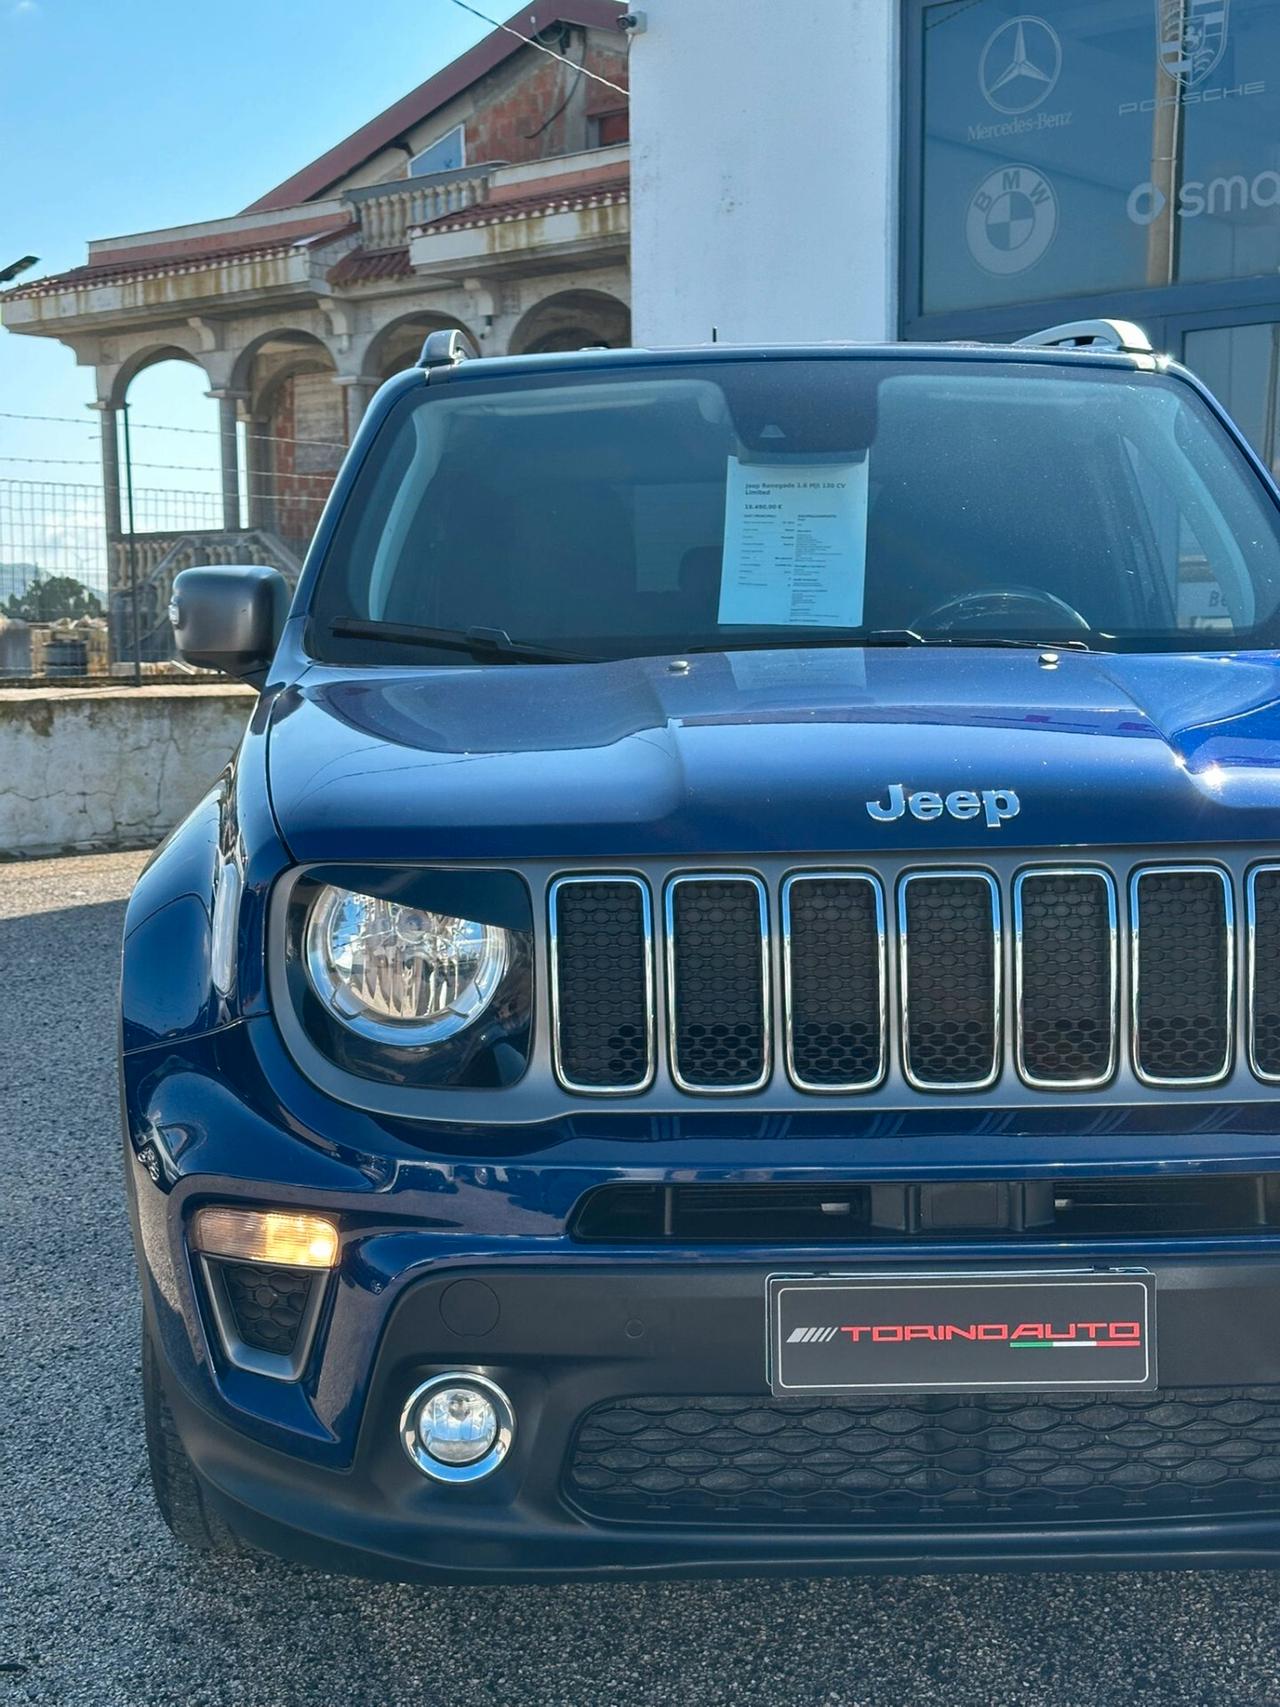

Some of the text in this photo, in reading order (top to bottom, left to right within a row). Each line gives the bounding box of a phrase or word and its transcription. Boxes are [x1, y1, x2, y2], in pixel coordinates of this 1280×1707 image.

[1118, 81, 1265, 117] PORSCHE
[967, 111, 1073, 142] Mercedes-Benz
[973, 169, 1052, 214] BMW
[762, 482, 795, 490] Renegade
[866, 784, 1020, 828] Jeep
